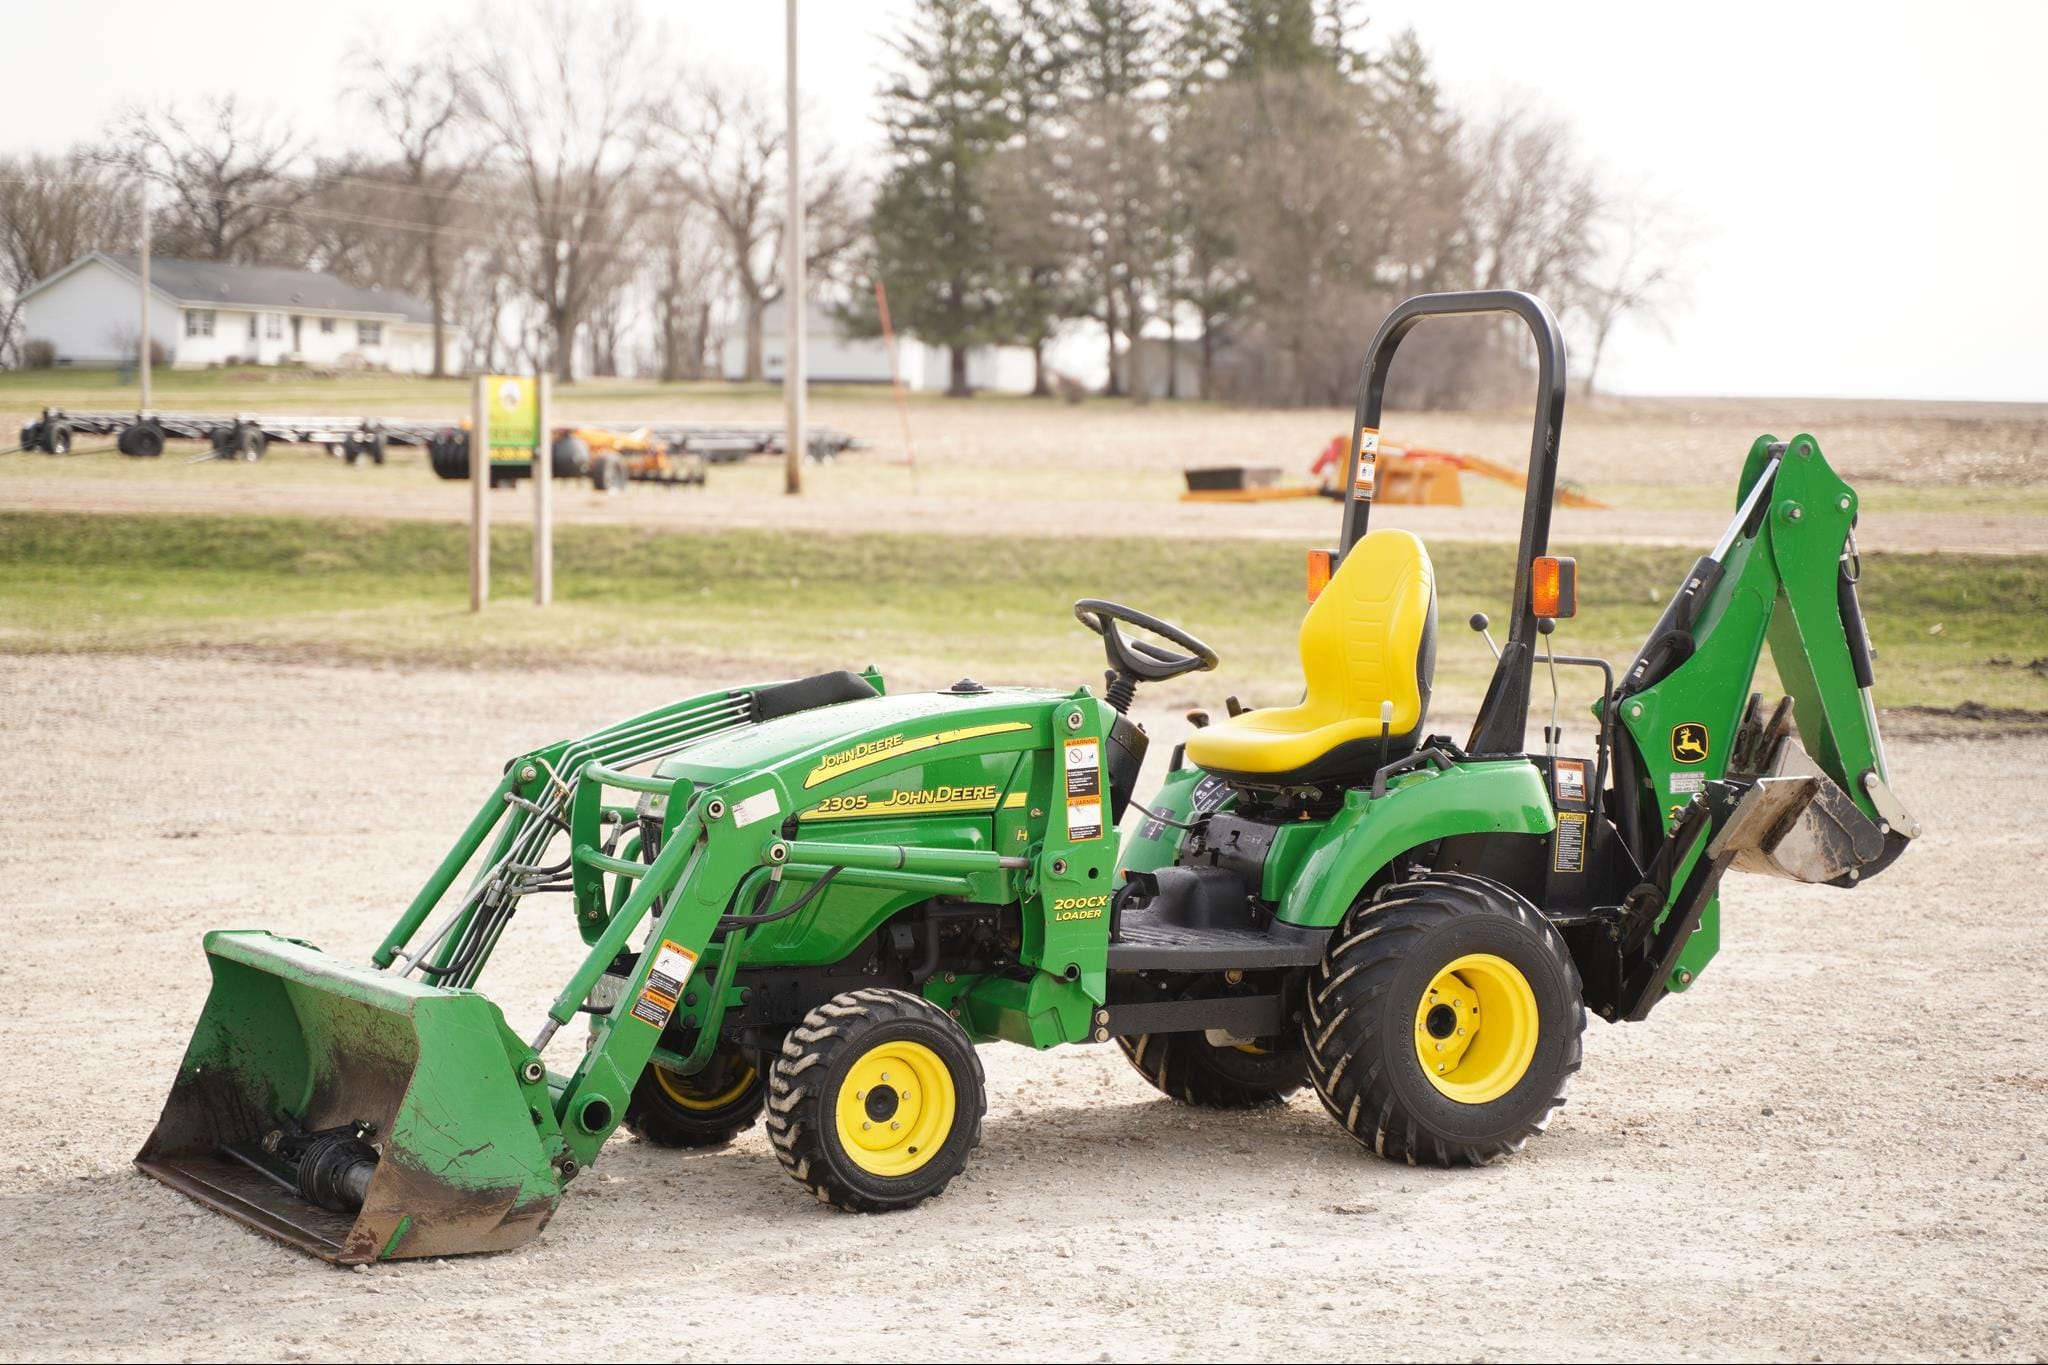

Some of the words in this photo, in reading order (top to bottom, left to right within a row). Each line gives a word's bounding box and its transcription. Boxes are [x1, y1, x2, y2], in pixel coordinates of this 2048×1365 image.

[1071, 738, 1097, 746] WARNING
[817, 748, 856, 771] JOHN
[854, 734, 904, 759] DEERE
[817, 794, 869, 813] 2305
[883, 789, 936, 807] JOHN
[934, 785, 997, 802] DEERE
[1565, 813, 1585, 821] CAUTION
[1053, 894, 1108, 912] 200CX
[1055, 909, 1102, 922] LOADER
